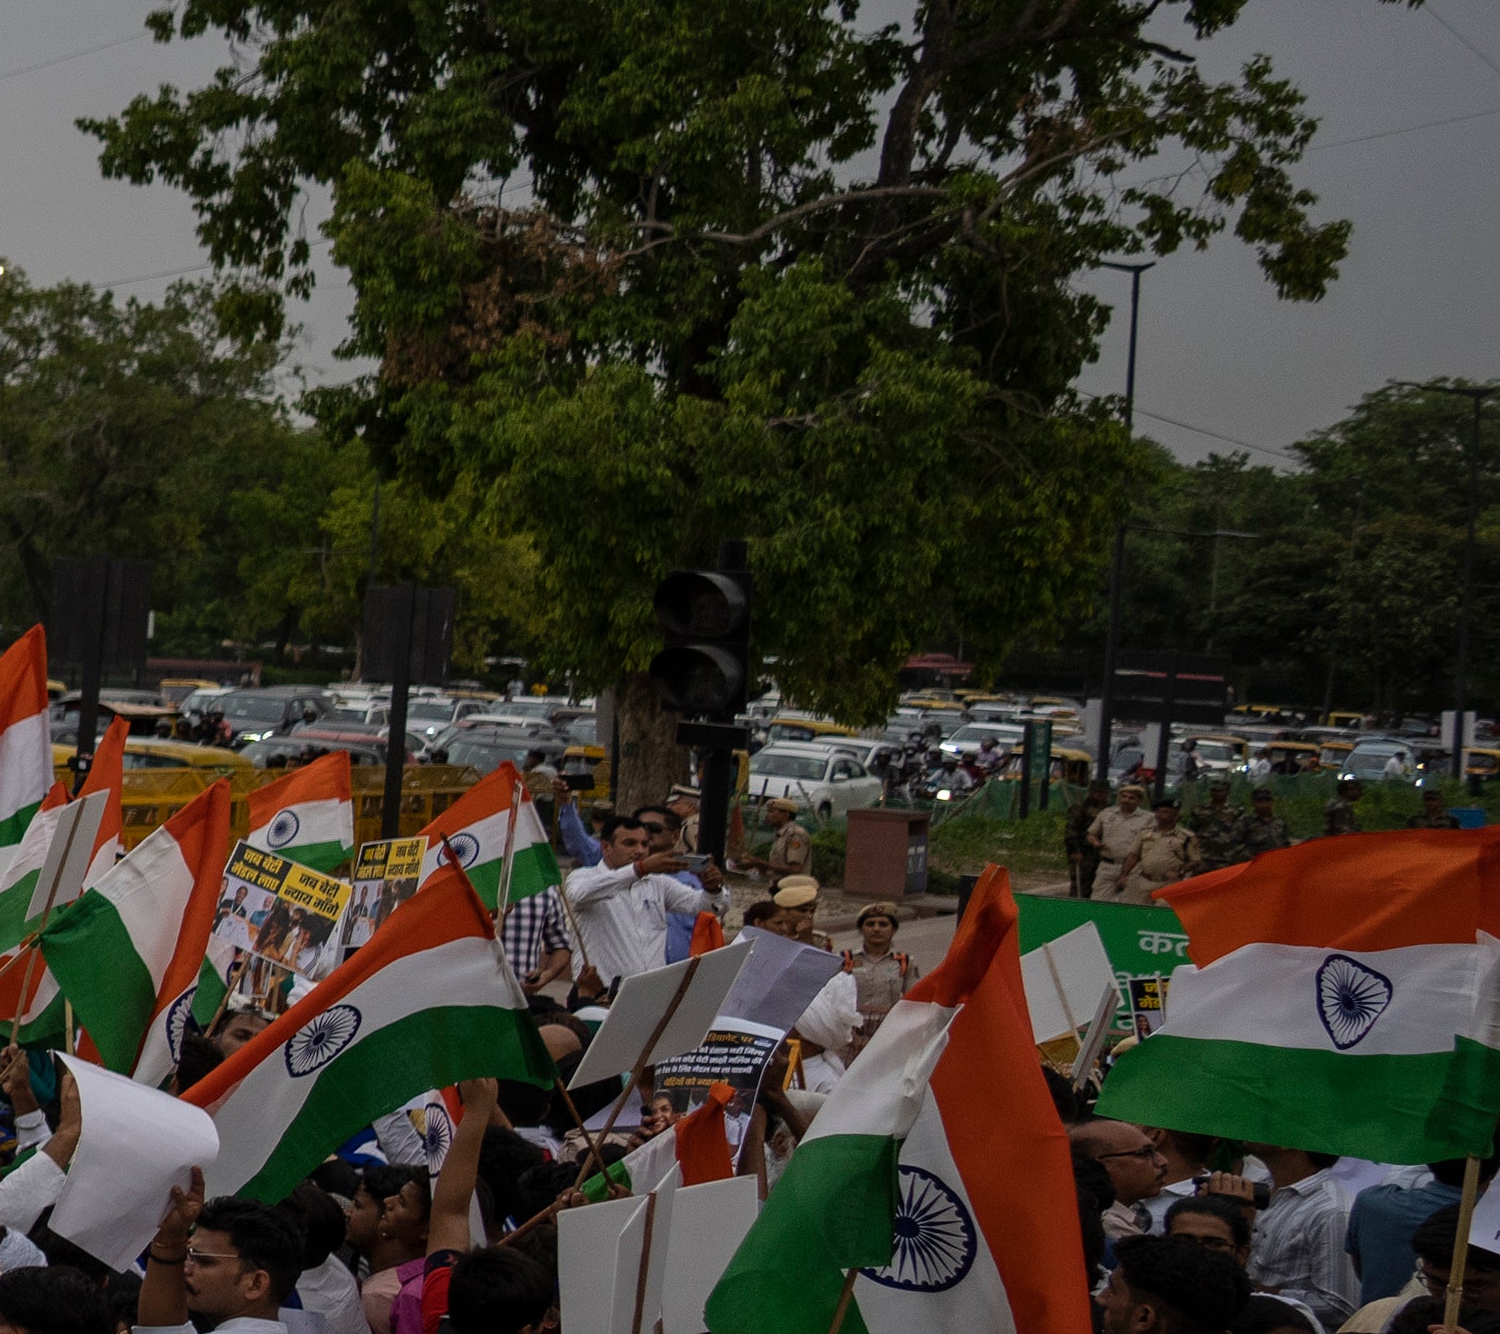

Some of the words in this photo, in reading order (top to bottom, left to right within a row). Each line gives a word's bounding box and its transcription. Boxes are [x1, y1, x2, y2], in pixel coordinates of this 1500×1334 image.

[284, 884, 313, 906] न्याय
[299, 873, 319, 889] जब
[319, 879, 340, 898] बेटी
